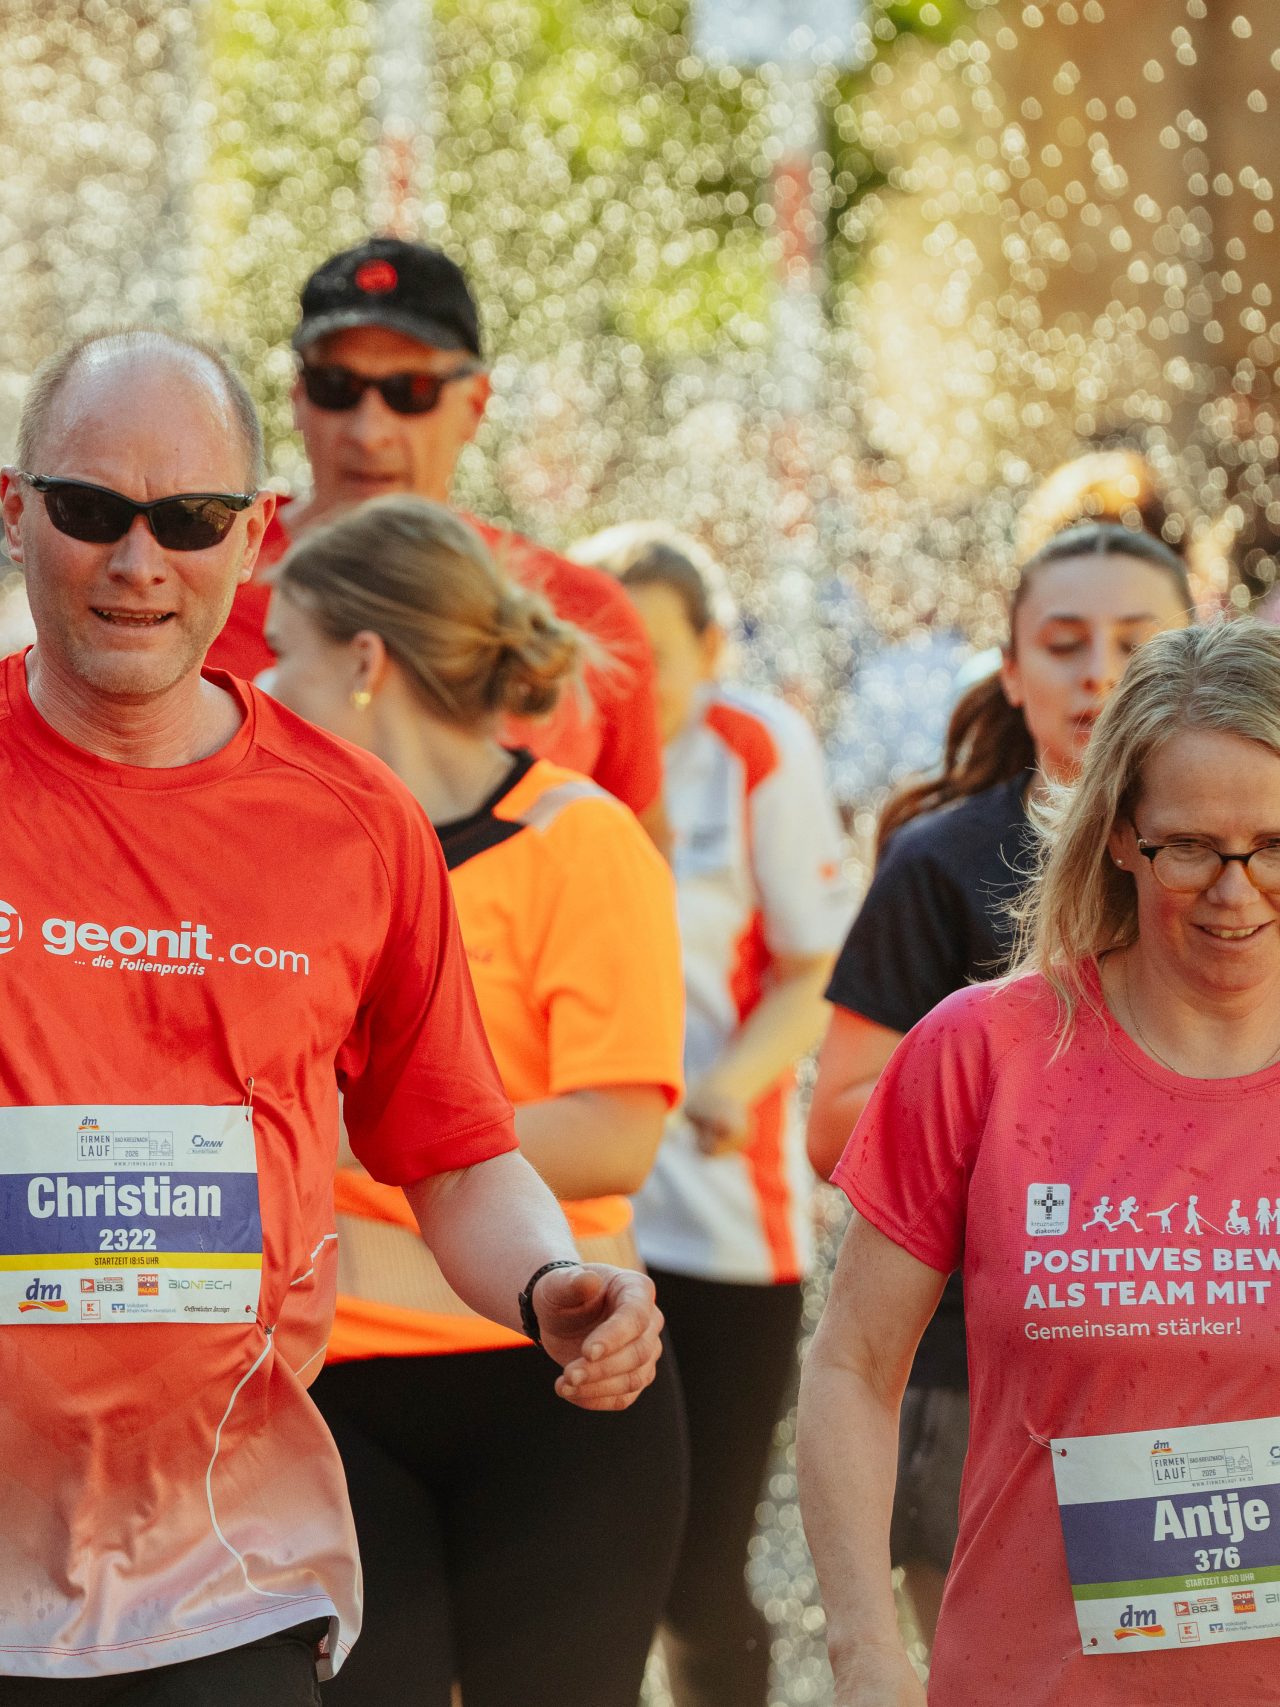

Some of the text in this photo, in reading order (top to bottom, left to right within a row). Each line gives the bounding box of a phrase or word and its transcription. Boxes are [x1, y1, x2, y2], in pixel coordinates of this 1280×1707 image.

[41, 917, 310, 976] geonit.com
[92, 955, 114, 969] die
[120, 957, 206, 977] Folienprofis
[82, 1116, 98, 1126] dm
[80, 1135, 111, 1144] FIRMEN
[80, 1144, 111, 1157] LAUF
[27, 1175, 222, 1219] Christian
[99, 1228, 157, 1251] 2322
[94, 1256, 128, 1266] STARTZEIT
[145, 1256, 160, 1265] UHR
[1023, 1247, 1202, 1274] POSITIVES
[137, 1275, 159, 1283] SCHUH
[168, 1279, 232, 1290] BIONTECH
[25, 1277, 62, 1300] dm
[96, 1283, 124, 1292] 88.3
[1023, 1280, 1272, 1310] ALS TEAM MIT
[1023, 1316, 1242, 1341] Gemeinsam stärker!
[1153, 1440, 1170, 1450] dm
[1154, 1456, 1186, 1468] FIRMEN
[1155, 1467, 1187, 1481] LAUF
[1201, 1468, 1217, 1477] 2026
[1153, 1492, 1271, 1543] Antje
[1194, 1546, 1241, 1572] 376
[1185, 1572, 1255, 1588] STARTZEIT 18:00 UHR
[1231, 1592, 1255, 1601] SCHUH
[1191, 1603, 1219, 1614] 88.3
[1120, 1604, 1157, 1628] dm
